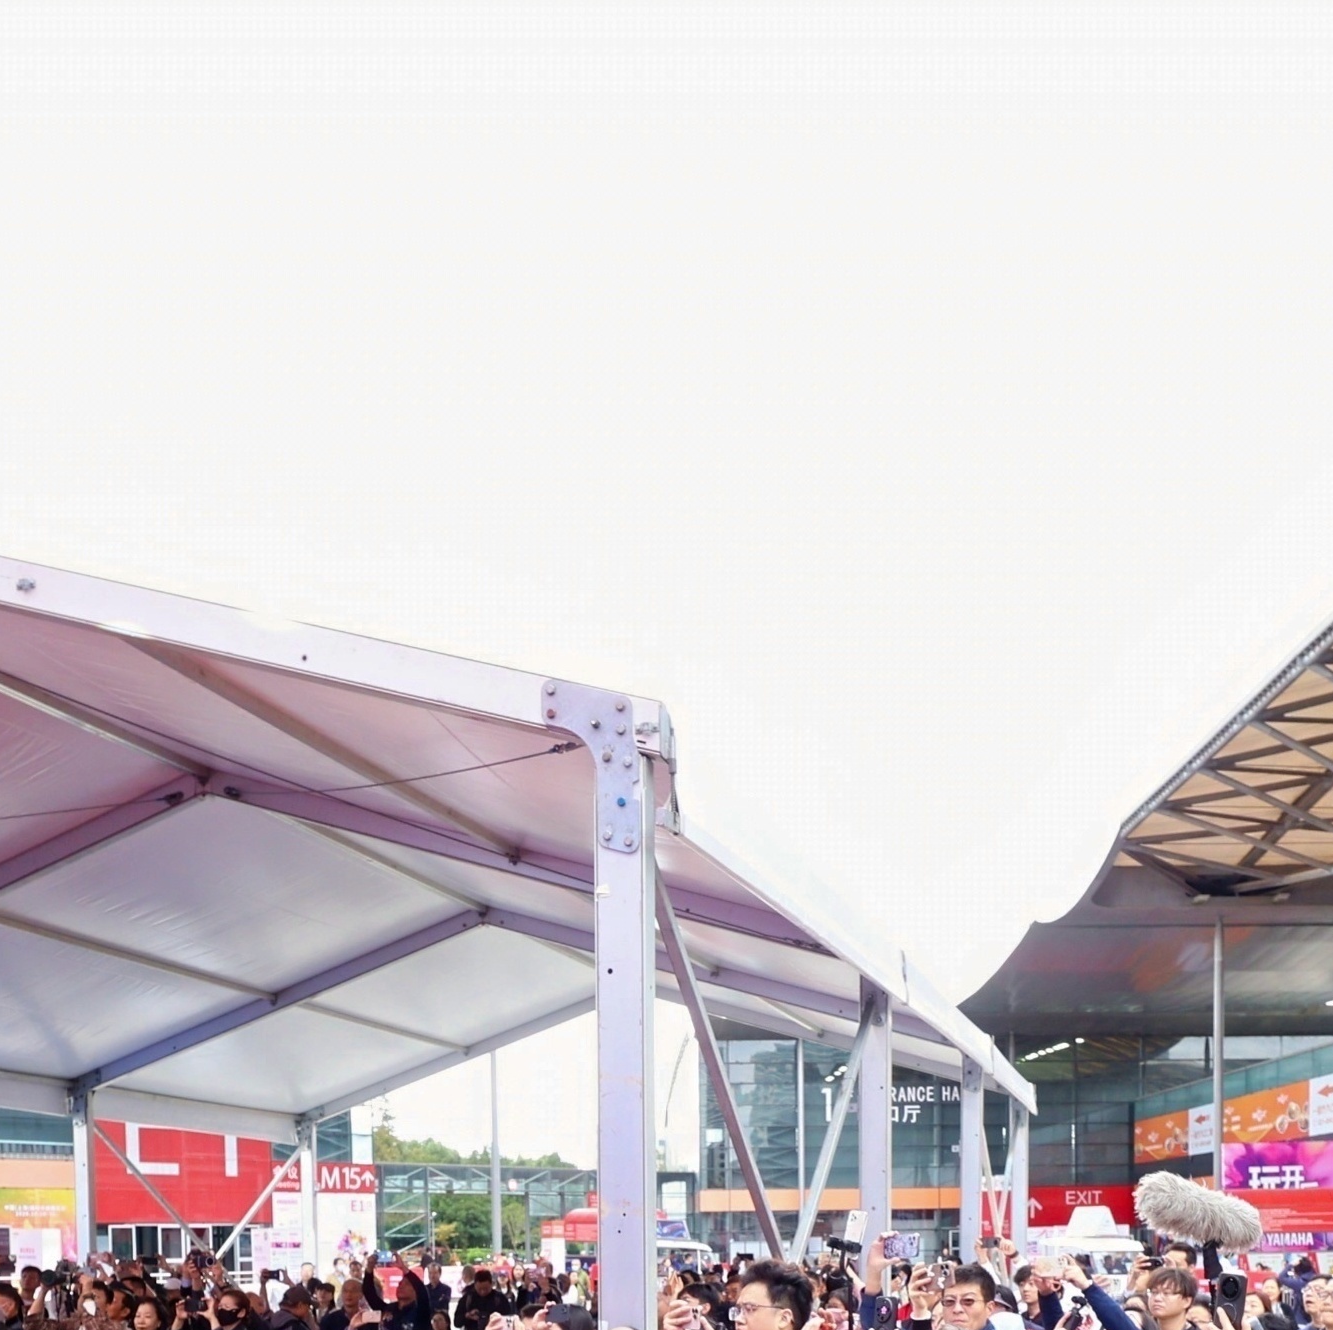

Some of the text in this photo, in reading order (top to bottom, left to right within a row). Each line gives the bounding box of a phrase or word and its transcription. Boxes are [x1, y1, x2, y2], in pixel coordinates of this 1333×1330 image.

[891, 1086, 961, 1102] RANCE HA
[891, 1105, 921, 1123] 口厅
[275, 1181, 300, 1190] eeting
[321, 1166, 361, 1190] M15
[1065, 1190, 1102, 1205] EXIT
[1268, 1232, 1314, 1246] YAMAHA
